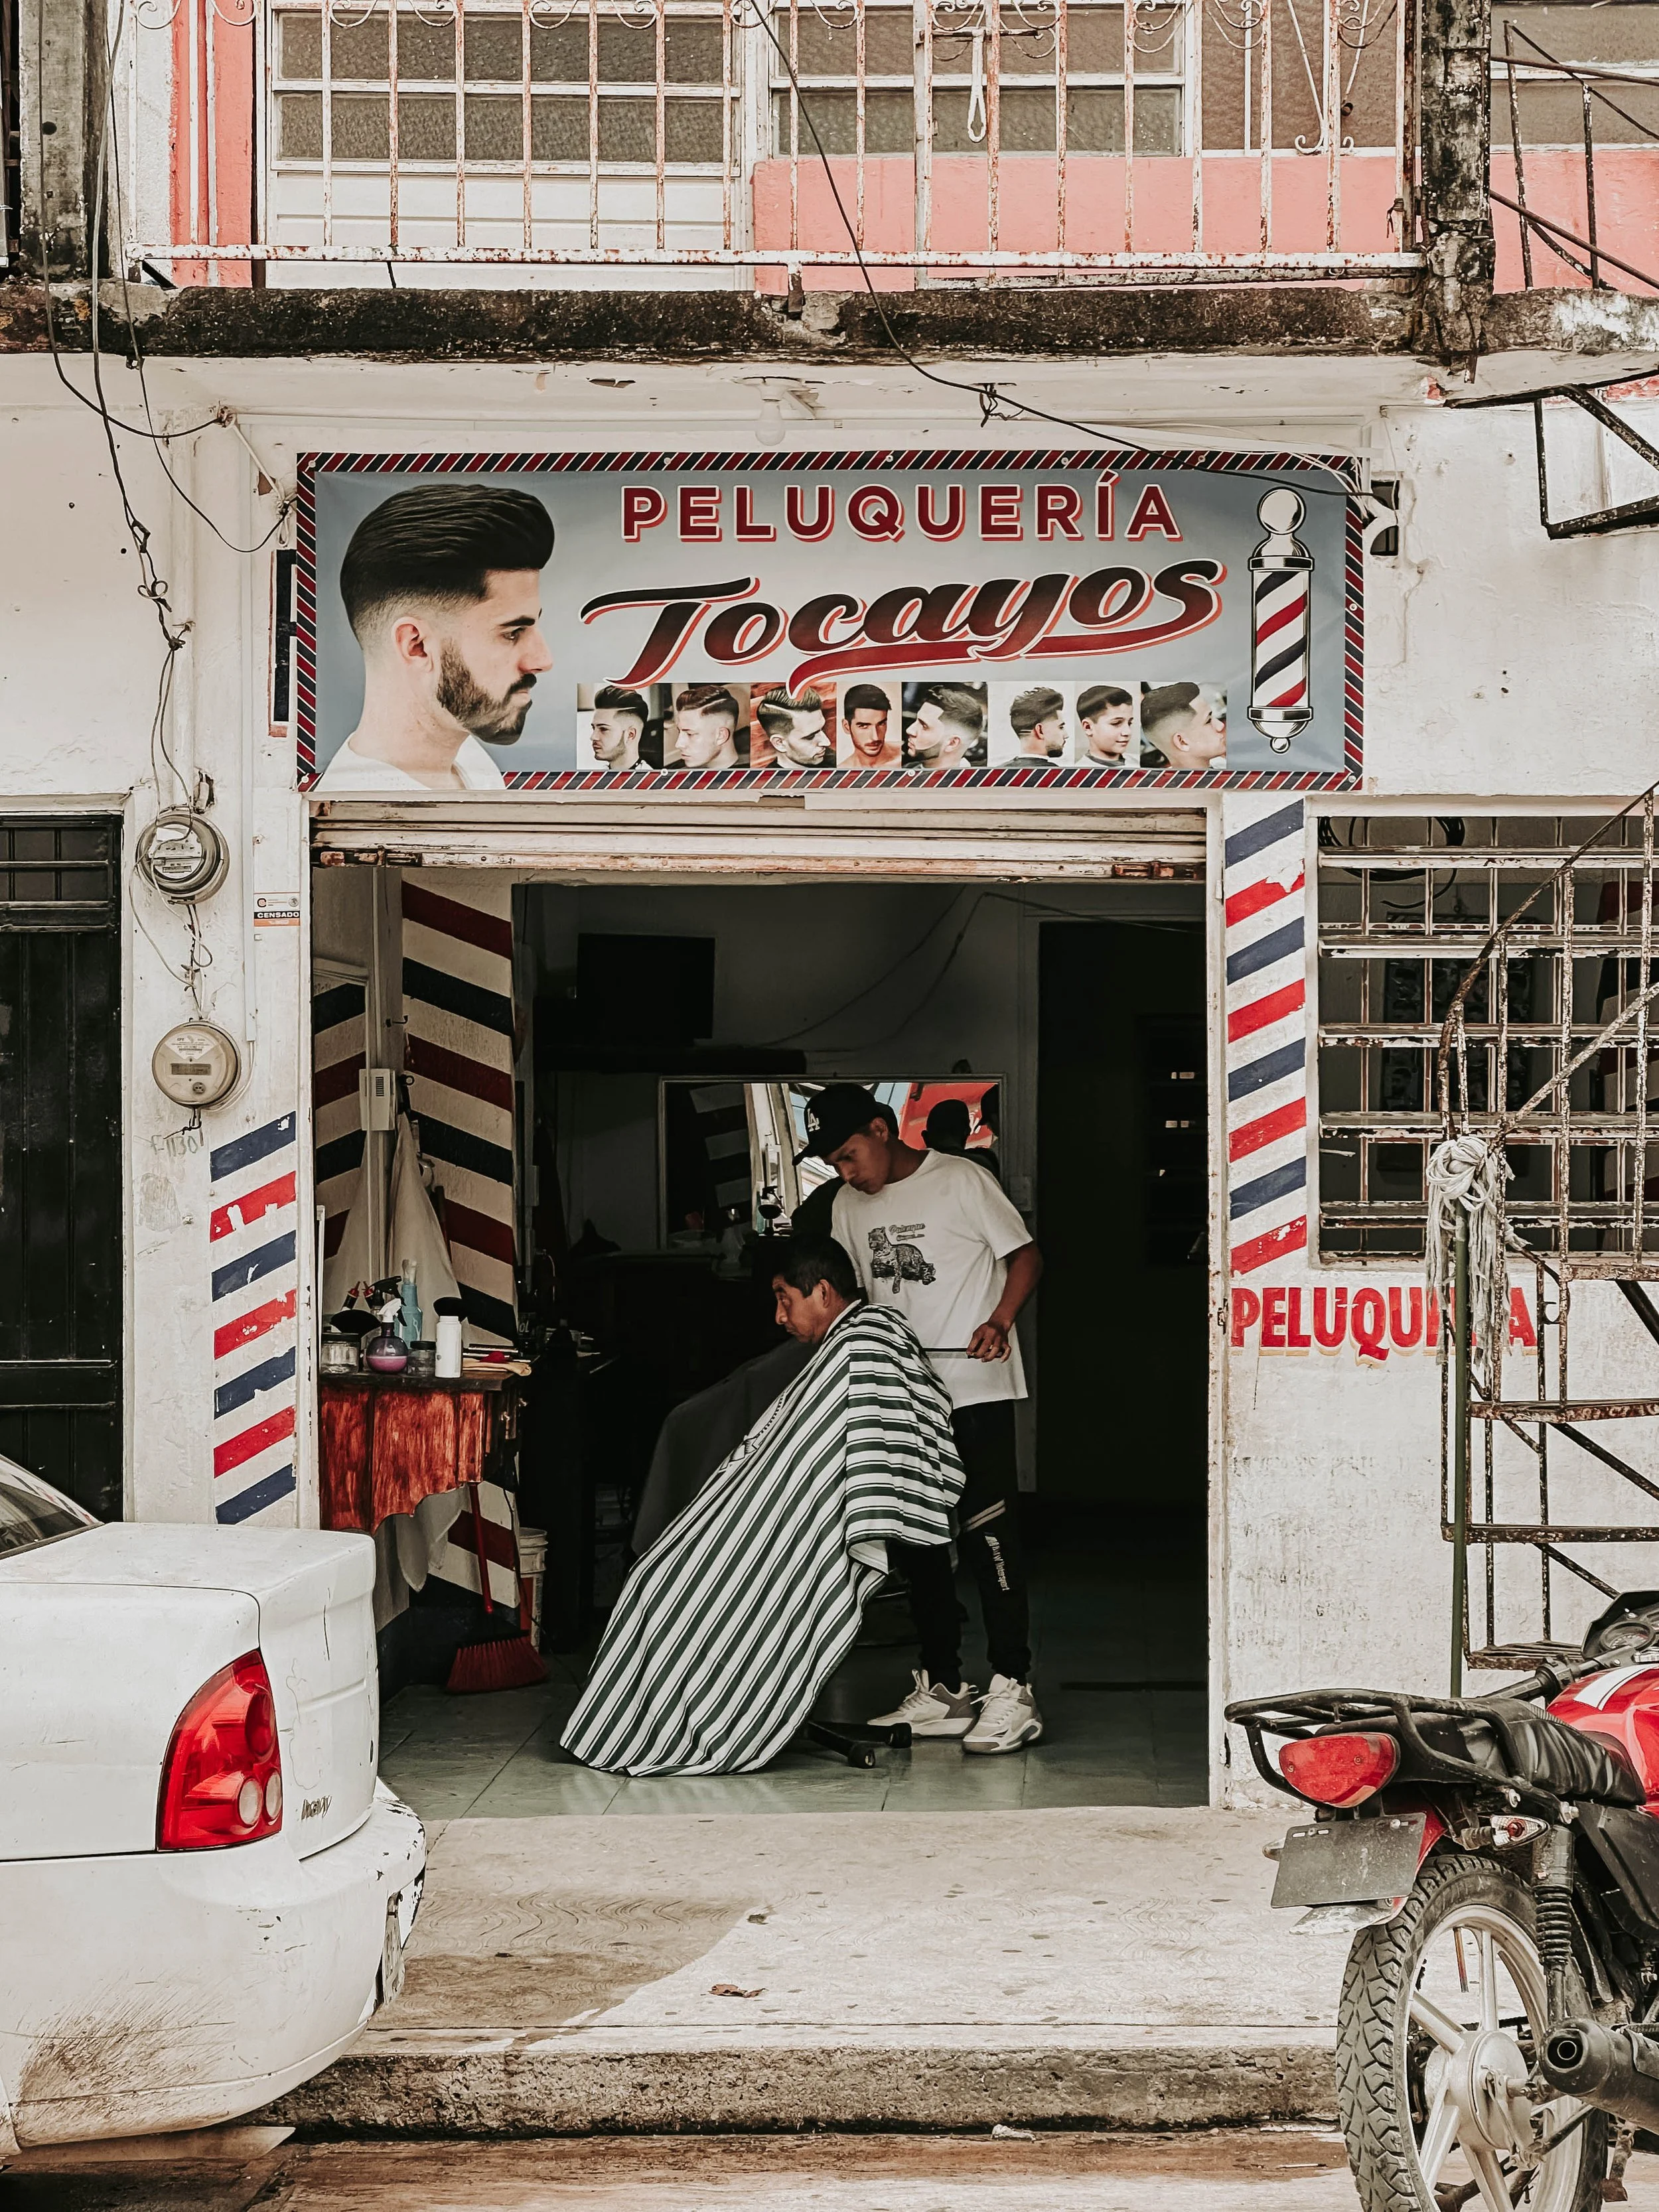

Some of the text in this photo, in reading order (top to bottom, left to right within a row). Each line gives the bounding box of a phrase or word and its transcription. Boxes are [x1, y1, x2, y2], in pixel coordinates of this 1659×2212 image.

[621, 472, 1184, 543] PELUQUERÍA
[579, 559, 1229, 700] Tocayos
[807, 1108, 820, 1132] LA
[1230, 1286, 1538, 1364] PELUQUA
